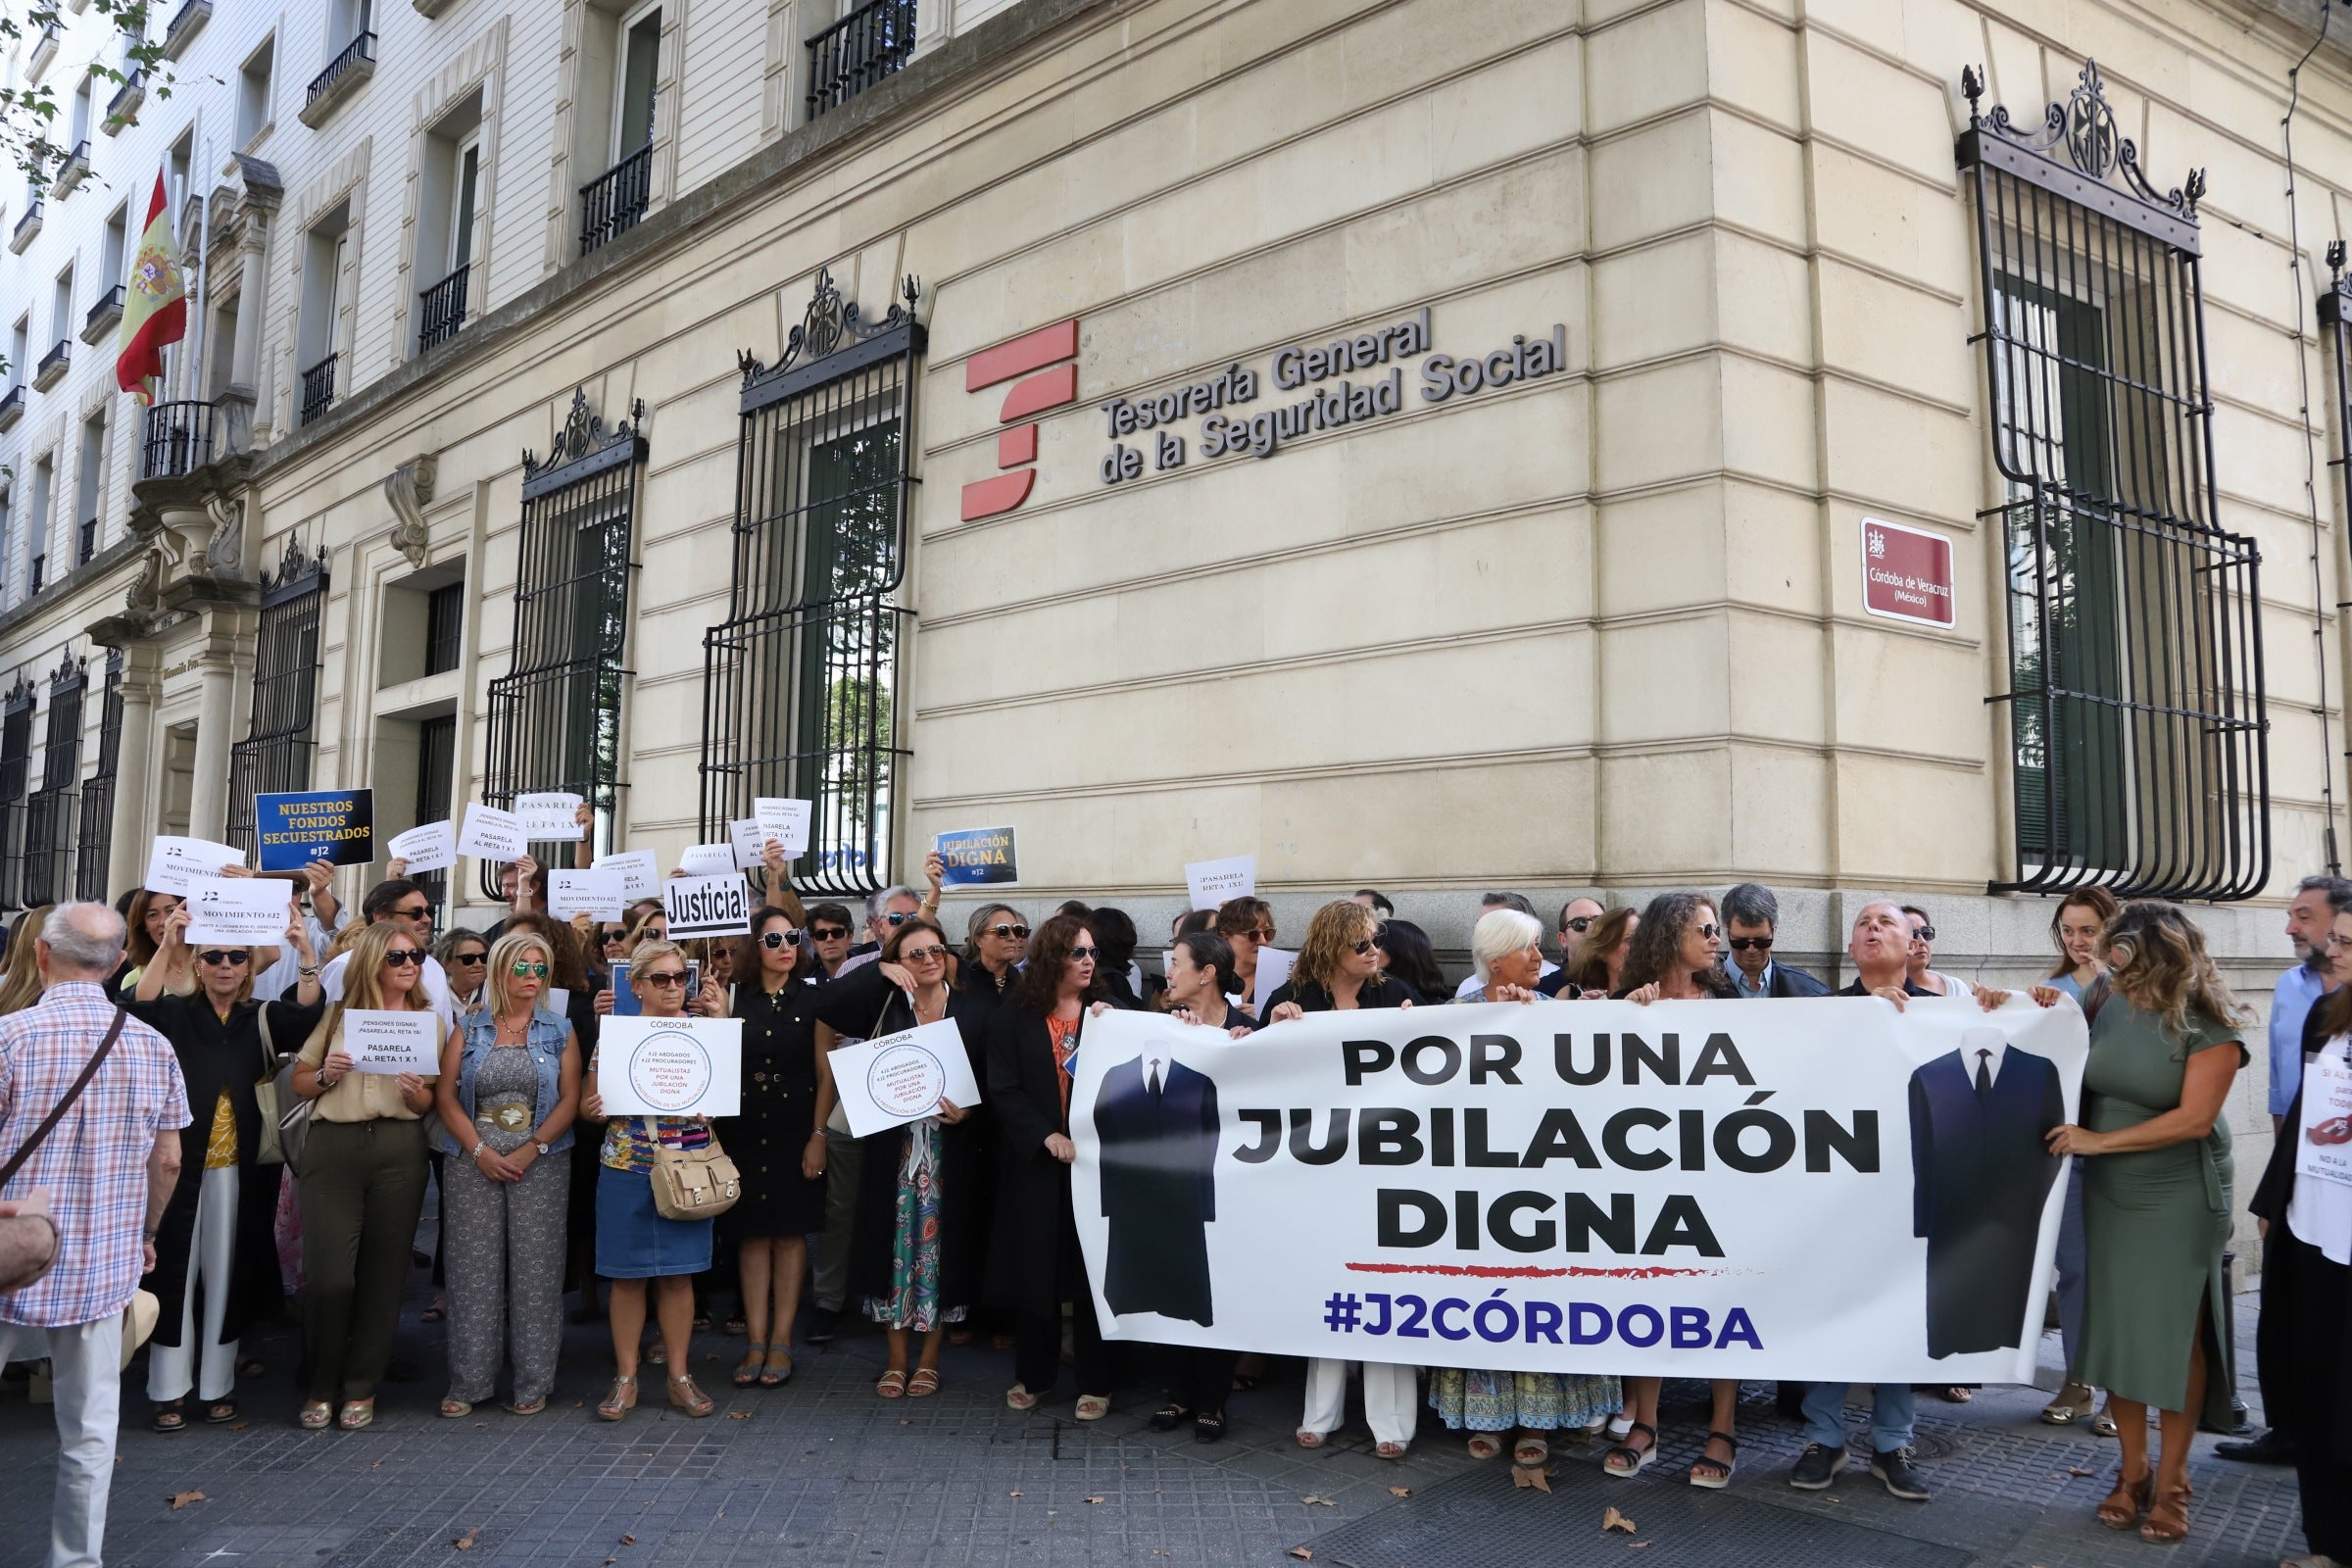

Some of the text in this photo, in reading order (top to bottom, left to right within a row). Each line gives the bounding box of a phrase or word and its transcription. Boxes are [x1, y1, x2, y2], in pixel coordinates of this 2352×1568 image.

[1100, 307, 1431, 438] Tesorería General
[1099, 322, 1567, 484] de la Seguridad Social
[1869, 567, 1949, 597] Córdoba de Veracruz
[1894, 590, 1927, 608] (México)
[278, 800, 354, 815] NUESTROS
[288, 815, 346, 829] FONDOS
[263, 826, 370, 845] SECUESTRADOS
[480, 832, 513, 844] PASARELA
[484, 842, 500, 851] RETA
[942, 834, 1009, 852] JUBILACIÓN
[167, 847, 182, 857] J2
[310, 846, 329, 857] #J2
[410, 846, 439, 857] PASARELA
[947, 849, 1006, 867] DIGNA
[166, 863, 220, 878] MOVIMIENTO
[1200, 872, 1244, 883] ¡PASARELA
[559, 880, 571, 889] J2
[201, 891, 219, 902] J2
[667, 879, 747, 924] Justicia!
[204, 910, 266, 919] MOVIMIENTO
[650, 1020, 693, 1029] CÓRDOBA
[368, 1044, 412, 1053] PASARELA
[873, 1033, 913, 1050] CÓRDOBA
[891, 1059, 920, 1072] ABOGADOS
[1342, 1033, 1756, 1086] POR UNA
[886, 1063, 928, 1079] PROCURADORES
[886, 1072, 925, 1088] MUTUALISTAS
[907, 1080, 921, 1089] UNA
[636, 1082, 662, 1106] PROTECCIÓN
[681, 1080, 707, 1105] MUTUALISTAS
[893, 1086, 927, 1100] JUBILACIÓN
[903, 1094, 922, 1103] DIGNA
[880, 1100, 909, 1114] PROTECCIÓN
[1232, 1091, 1881, 1173] JUBILACIÓN
[2320, 1154, 2331, 1163] NO
[1377, 1188, 1725, 1258] DIGNA
[1323, 1289, 1763, 1350] #J2CÓRDOBA
